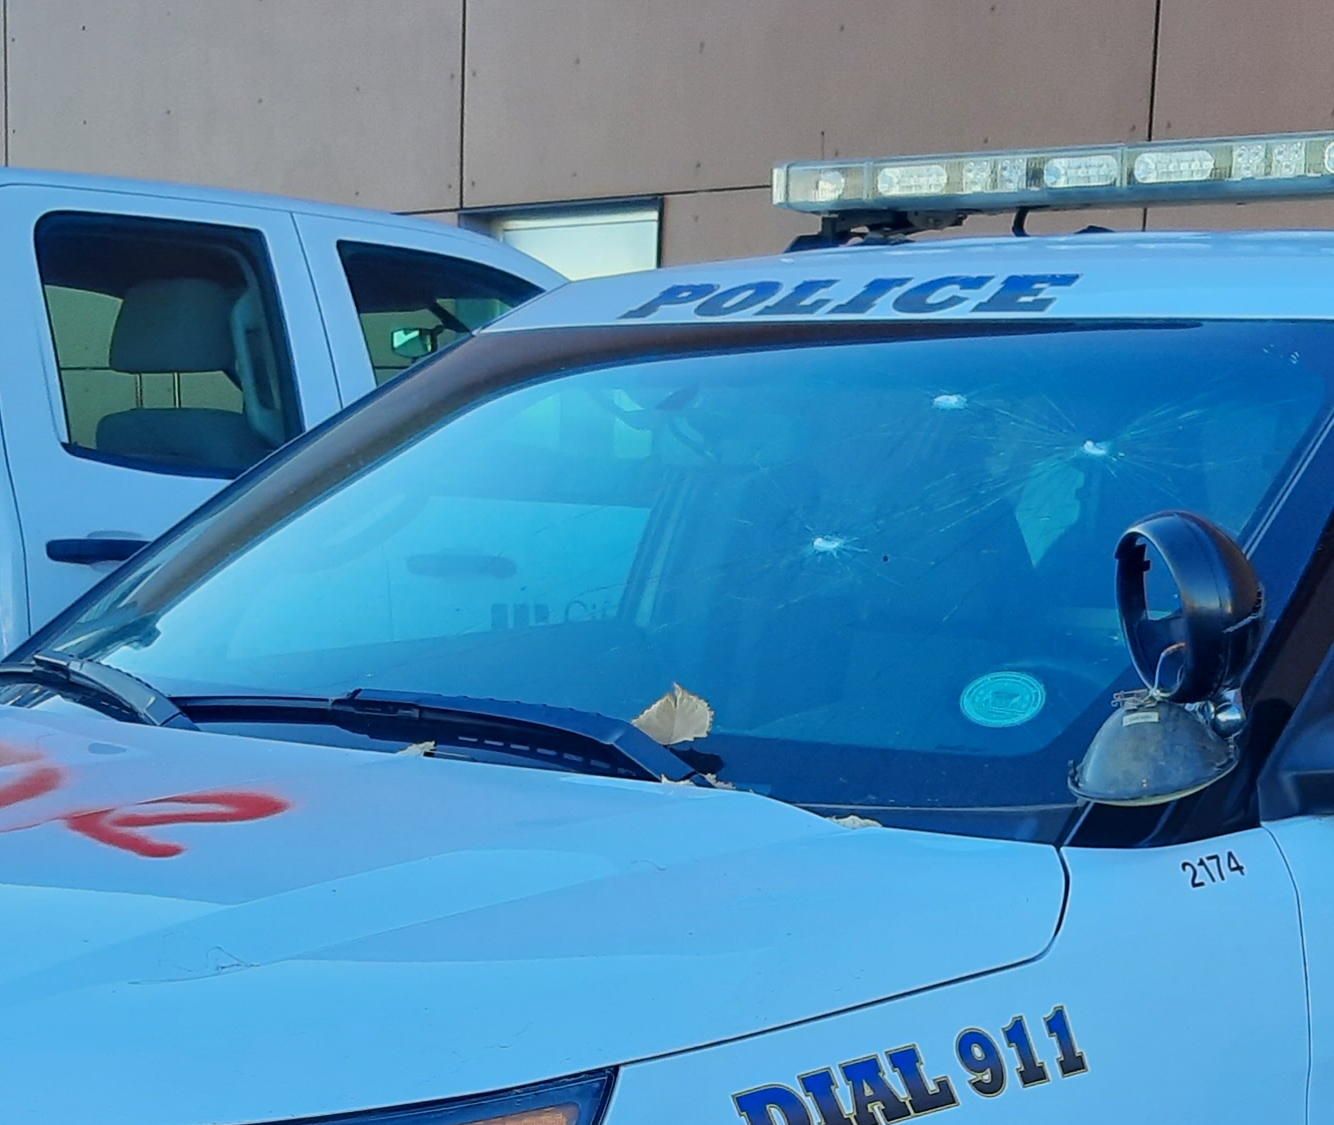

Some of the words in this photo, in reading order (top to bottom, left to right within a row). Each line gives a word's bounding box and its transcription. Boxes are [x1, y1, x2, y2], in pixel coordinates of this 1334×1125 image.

[615, 273, 1085, 320] POLICE
[1180, 851, 1246, 889] 2174
[955, 1005, 1089, 1098] 911
